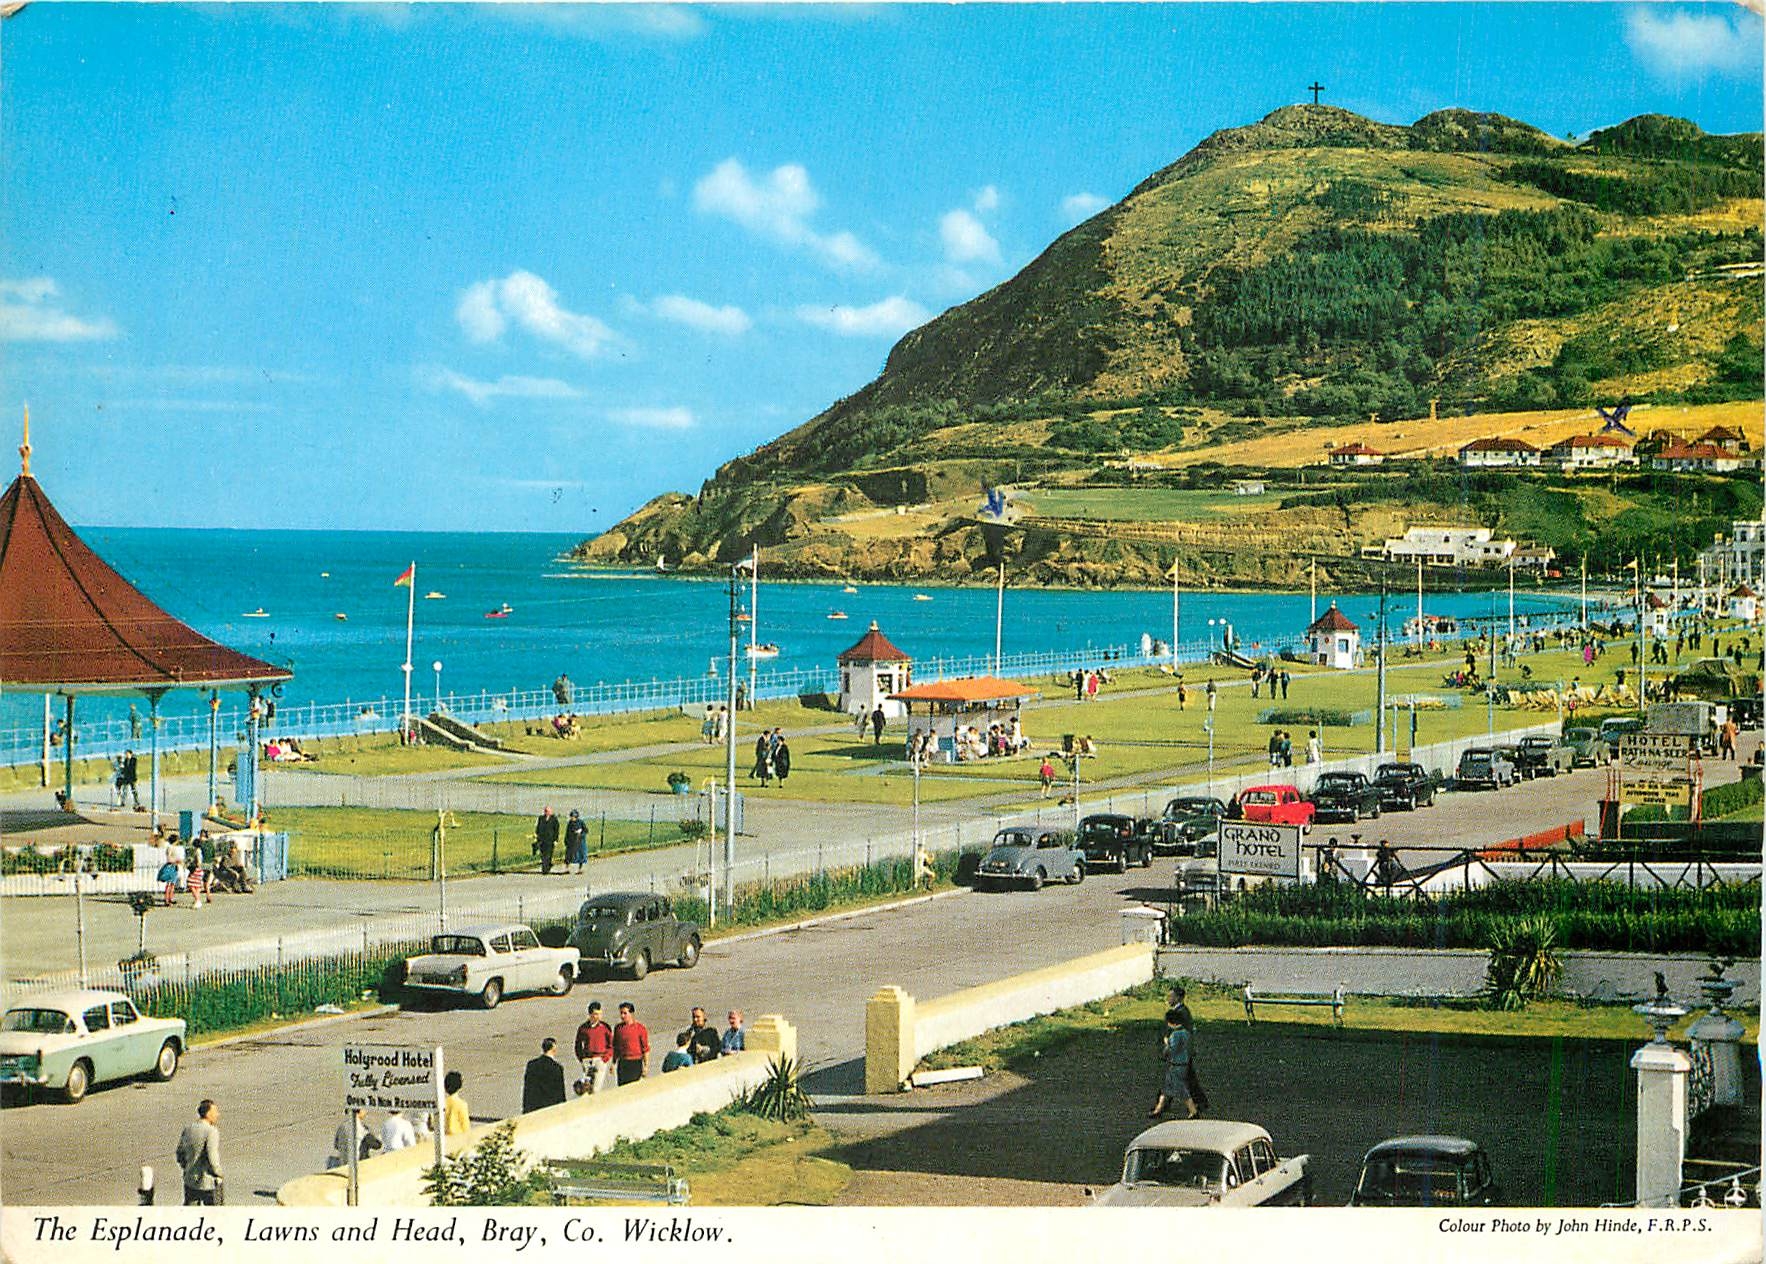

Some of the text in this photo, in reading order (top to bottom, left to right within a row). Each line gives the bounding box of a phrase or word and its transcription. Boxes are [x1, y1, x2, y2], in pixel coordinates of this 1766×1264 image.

[1627, 735, 1682, 747] HOTEL
[1224, 828, 1281, 843] GRAND
[1236, 840, 1286, 858] HOTEL
[344, 1049, 433, 1070] Holyrood Hotel
[350, 1070, 431, 1091] Fully Licensed
